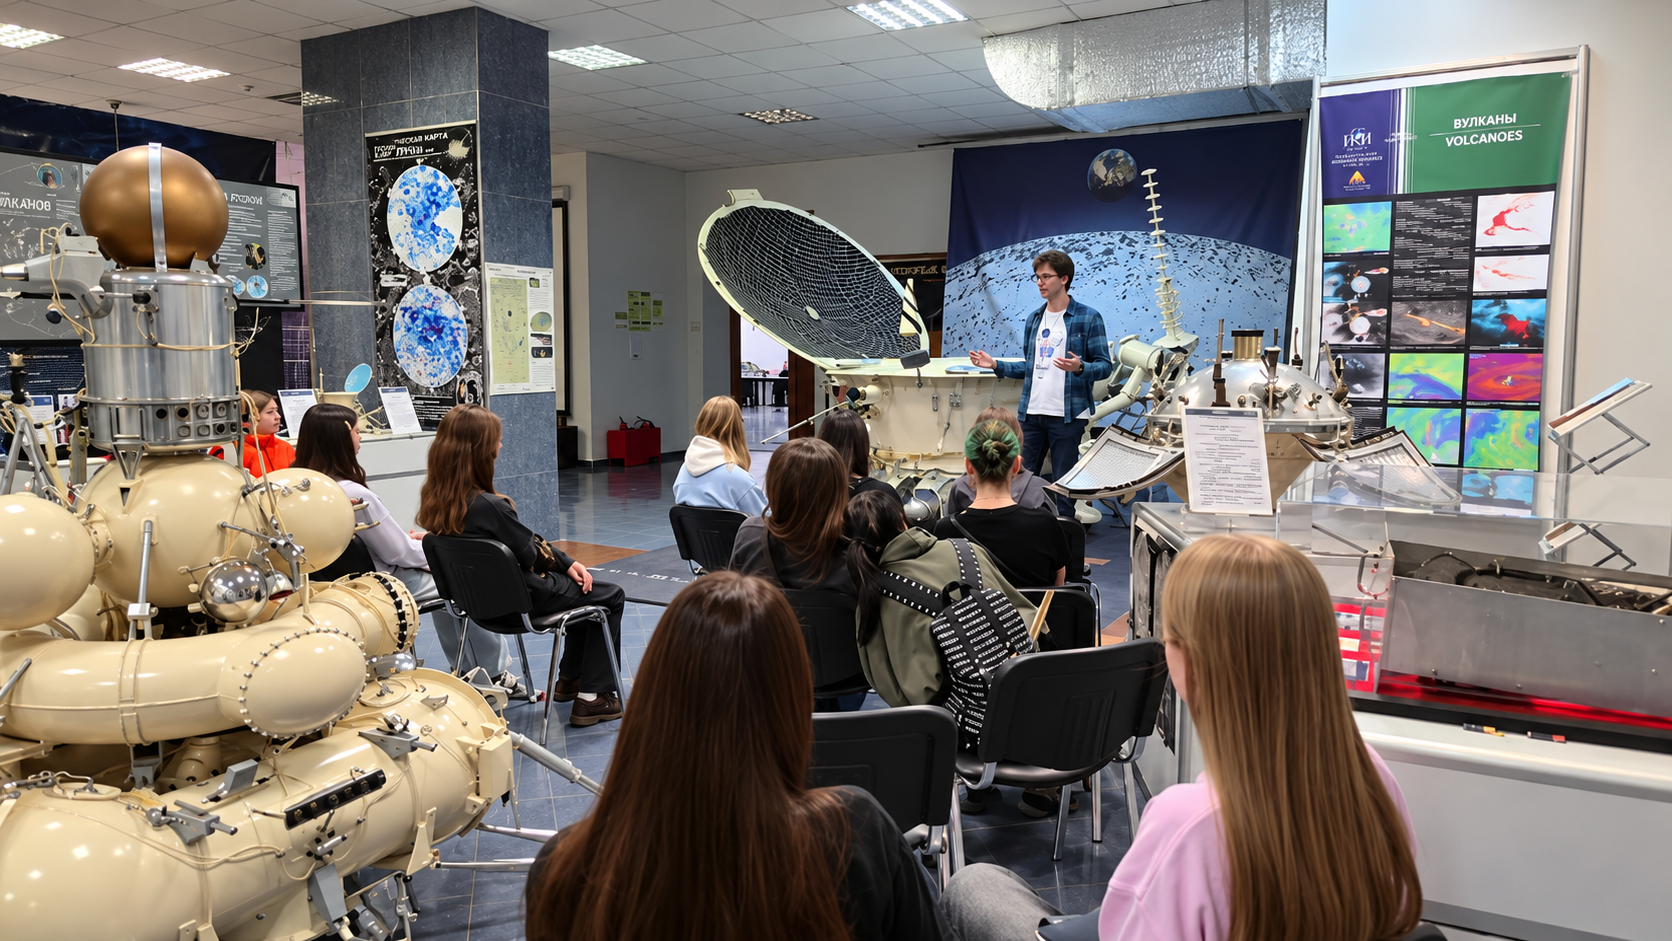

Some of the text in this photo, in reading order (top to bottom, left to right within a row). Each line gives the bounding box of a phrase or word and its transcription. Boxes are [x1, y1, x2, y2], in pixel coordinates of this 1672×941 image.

[1453, 113, 1517, 129] ВУЛКАНЫ
[424, 132, 448, 142] КАРТА
[1445, 129, 1523, 147] VOLCANOES
